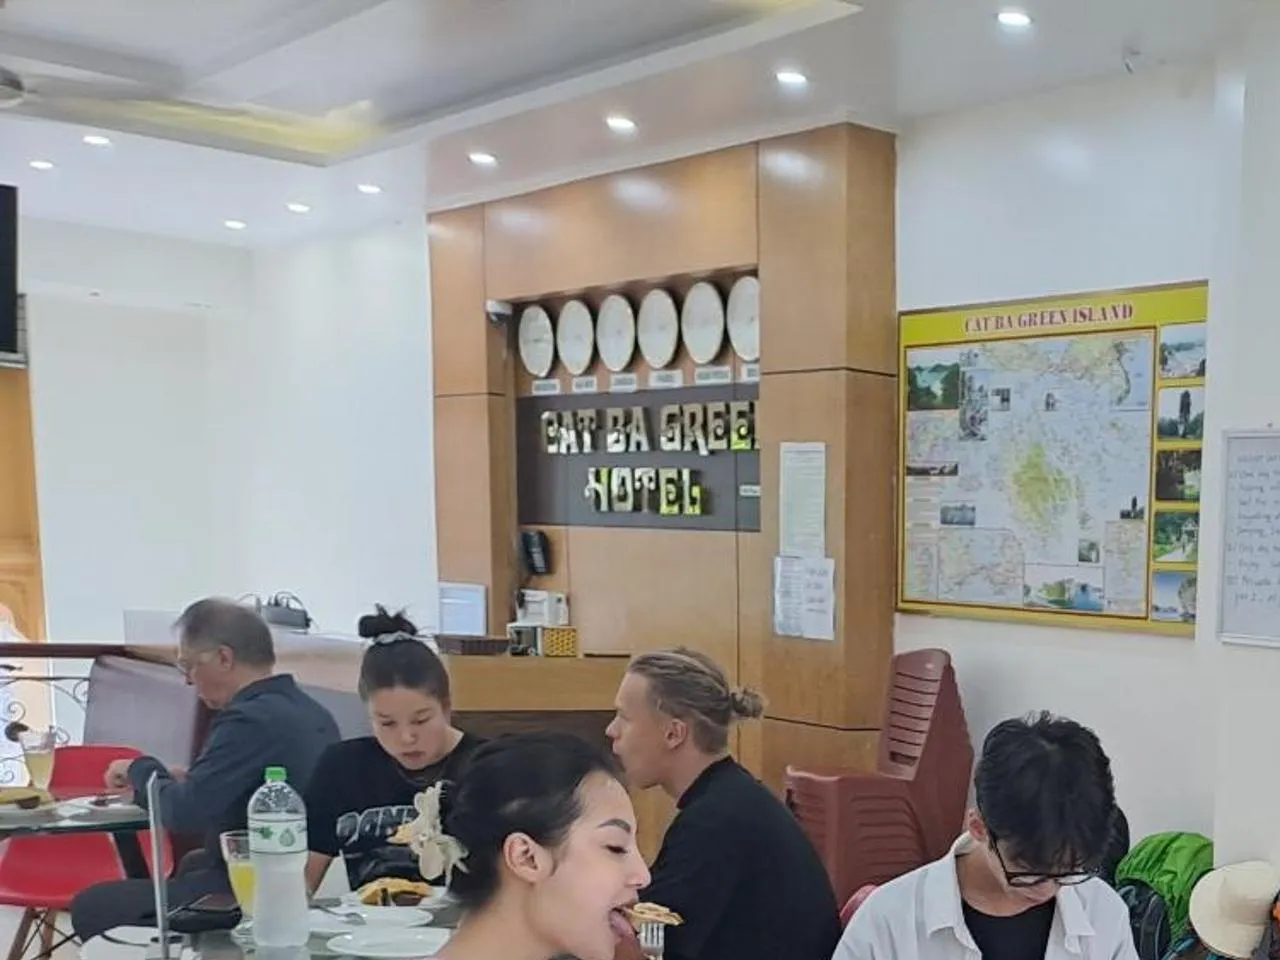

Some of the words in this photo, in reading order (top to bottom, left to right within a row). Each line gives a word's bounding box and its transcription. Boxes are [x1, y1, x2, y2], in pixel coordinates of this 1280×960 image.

[964, 315, 988, 333] CAT
[994, 314, 1013, 330] BA
[1018, 309, 1067, 328] GREEN
[1072, 302, 1133, 324] ISLAND
[541, 409, 597, 454] CAT
[606, 406, 651, 453] BA
[660, 400, 759, 456] GREE
[584, 467, 701, 516] HOTEL
